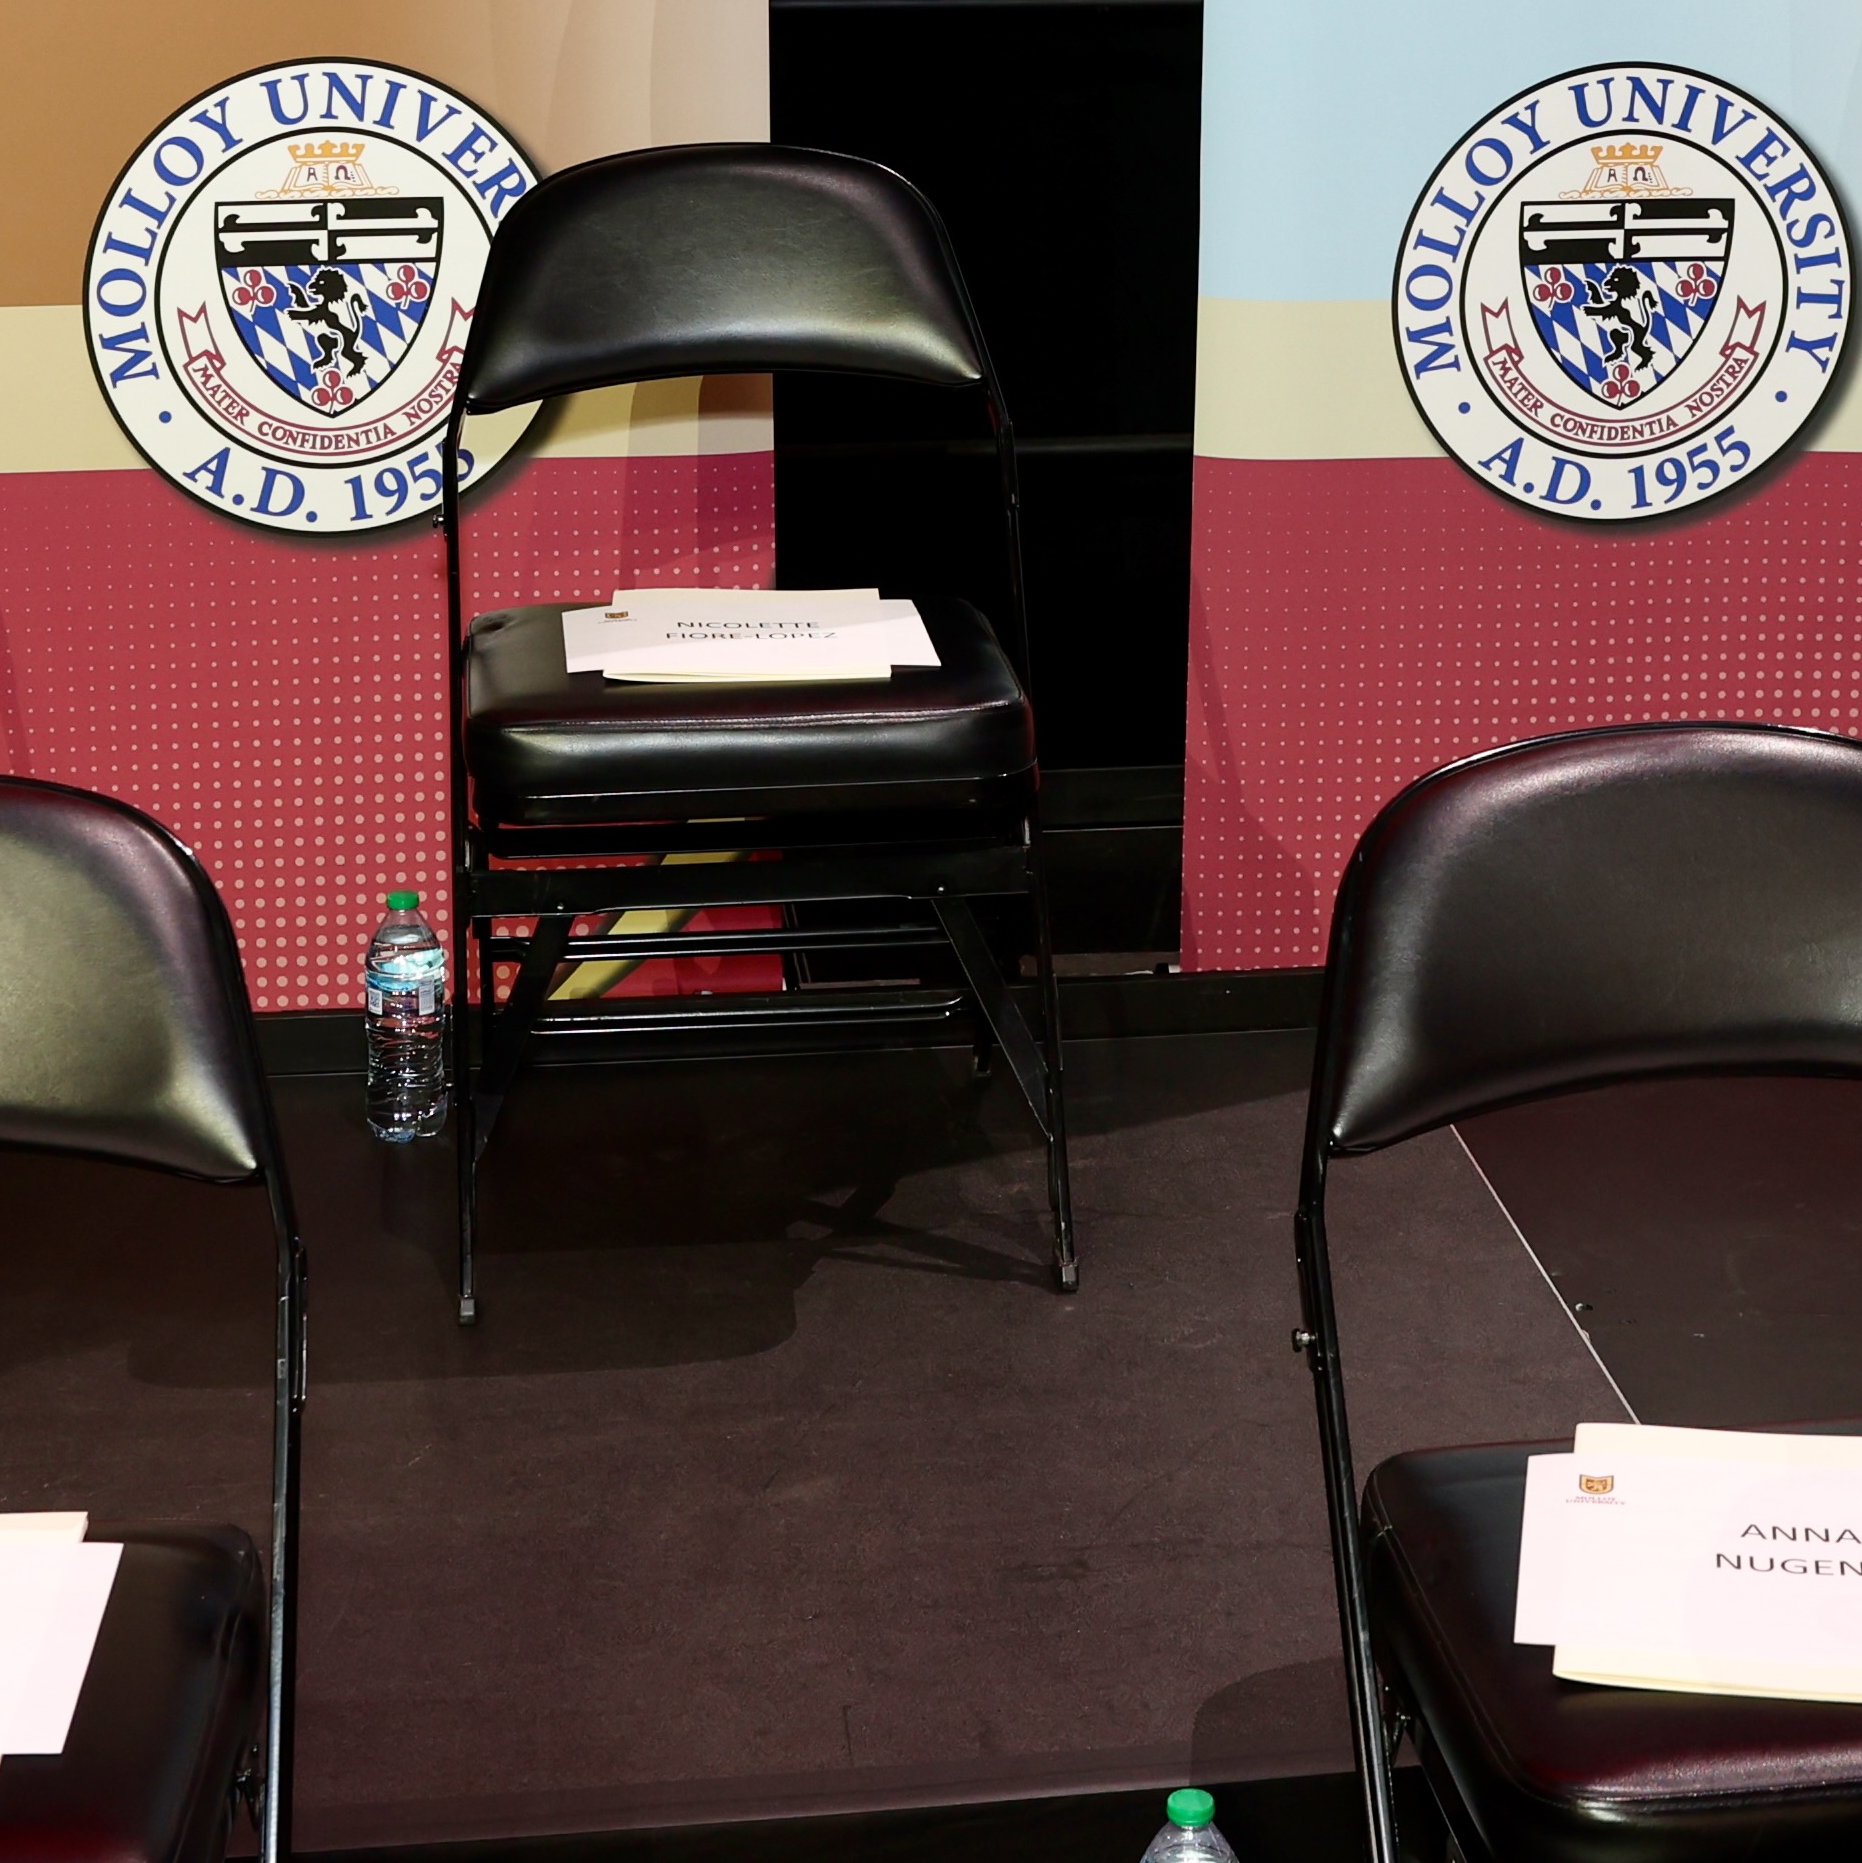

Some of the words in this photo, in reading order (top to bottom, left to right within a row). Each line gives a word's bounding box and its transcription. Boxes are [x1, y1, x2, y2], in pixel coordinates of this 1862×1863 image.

[96, 96, 243, 389] MOLLOY
[259, 71, 528, 218] UNIVER
[1405, 99, 1552, 380] MOLLOY
[1567, 75, 1846, 373] UNIVERSITY
[193, 364, 250, 425] MATER
[257, 422, 397, 449] CONFIDENTIA
[1491, 356, 1544, 416] MATER
[1550, 412, 1679, 442] CONFIDENTIA
[1684, 355, 1749, 419] NOSTRA
[183, 446, 318, 522] A.D.
[1478, 436, 1602, 511] A.D.
[1626, 425, 1752, 510] 1955
[1740, 1523, 1862, 1545] ANNA
